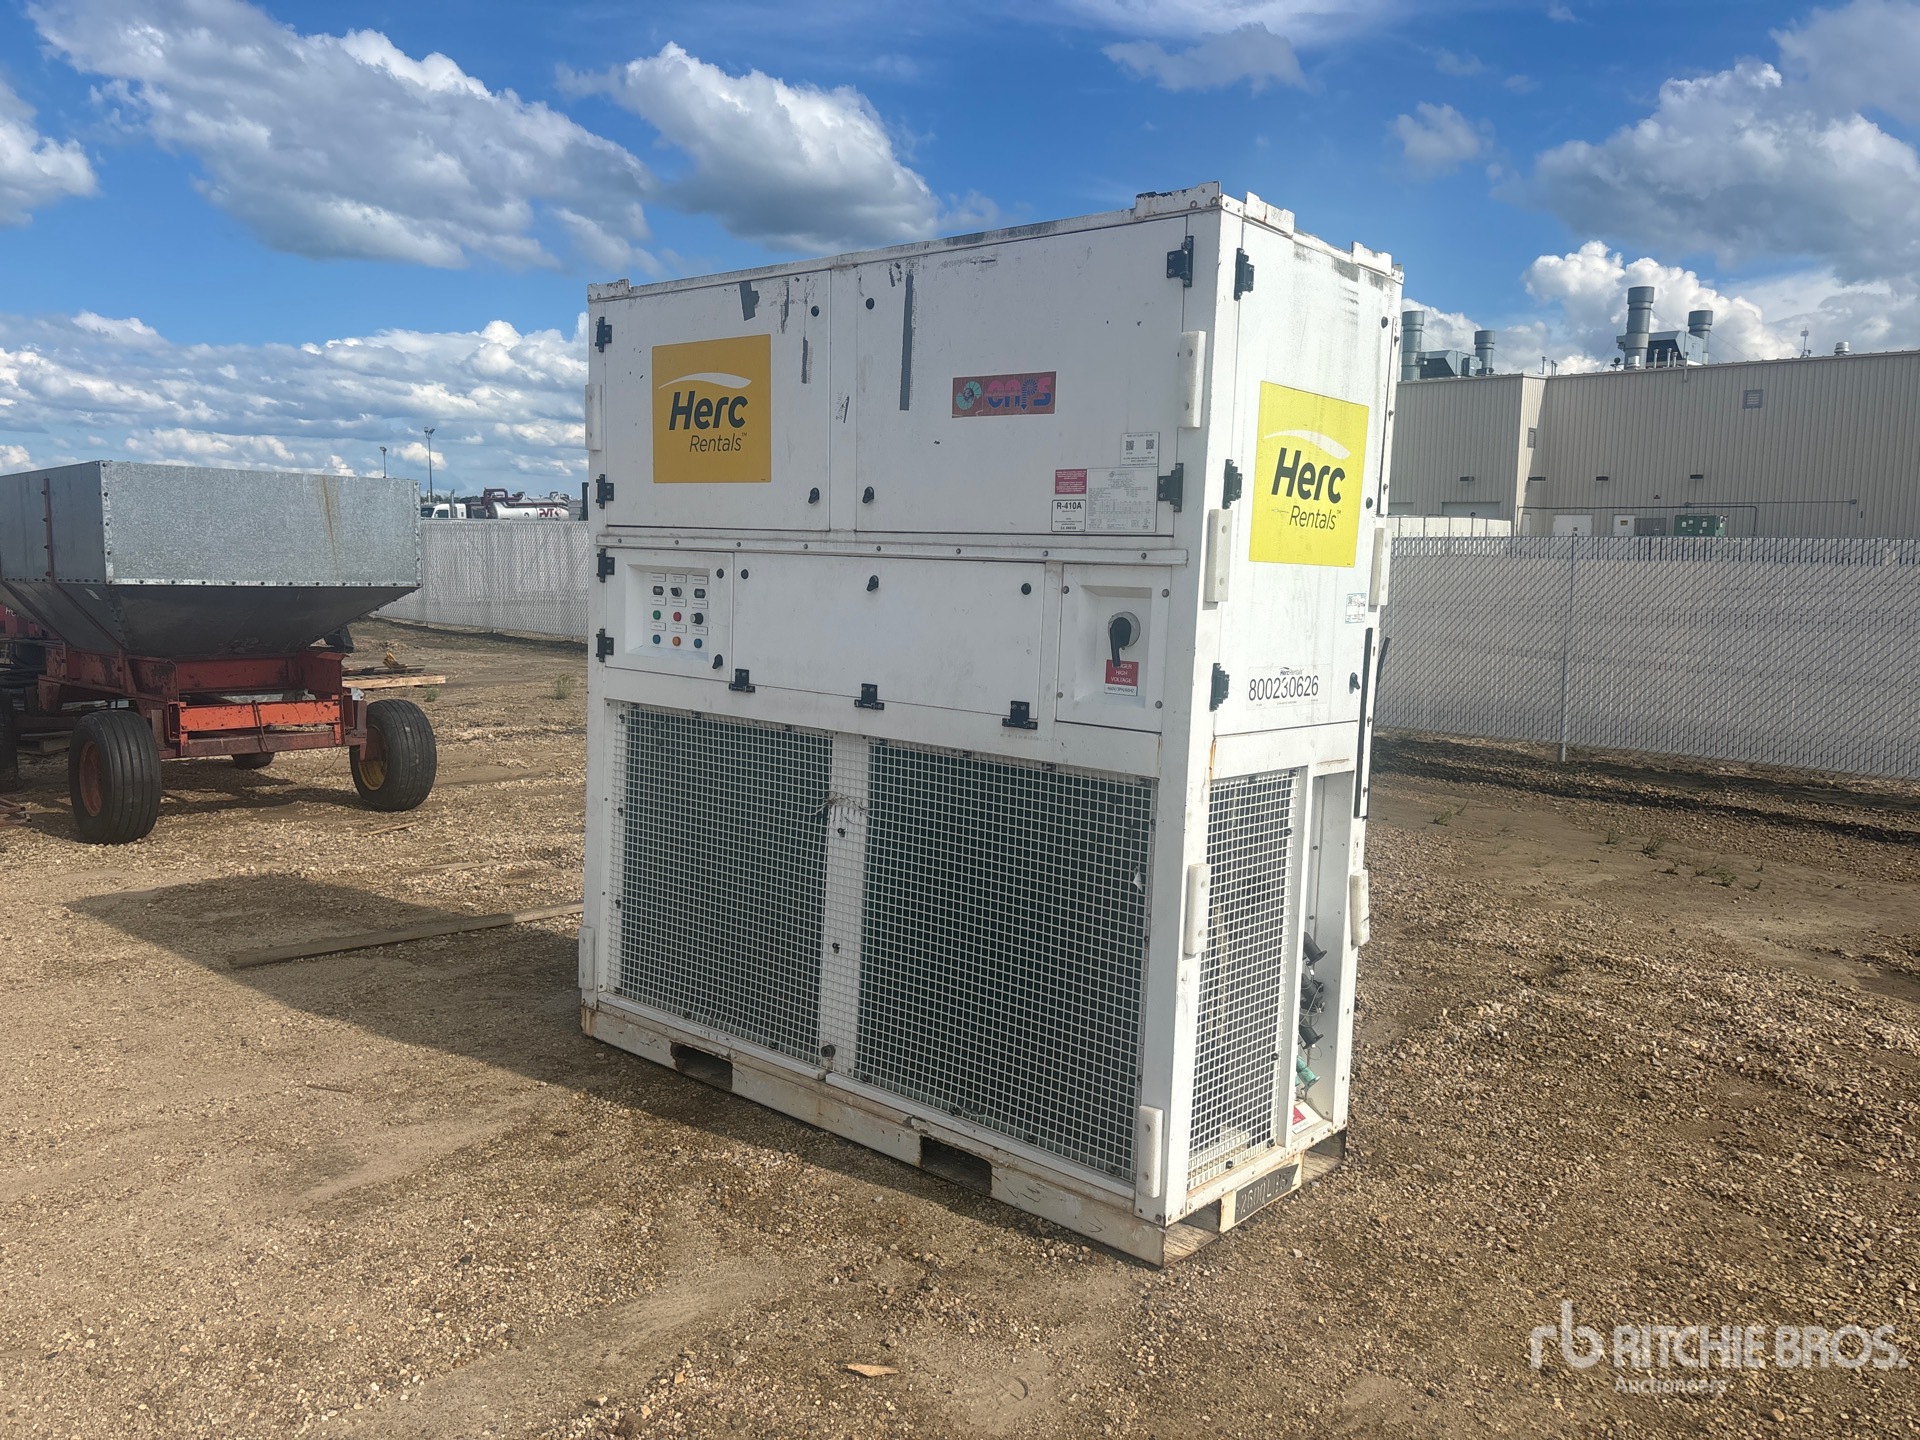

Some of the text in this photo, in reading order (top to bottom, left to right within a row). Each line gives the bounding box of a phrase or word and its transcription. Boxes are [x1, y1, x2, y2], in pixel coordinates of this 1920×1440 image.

[669, 391, 748, 430] Herc
[1271, 447, 1345, 503] Herc
[1057, 502, 1082, 510] R-410A
[1249, 675, 1319, 701] 800230626
